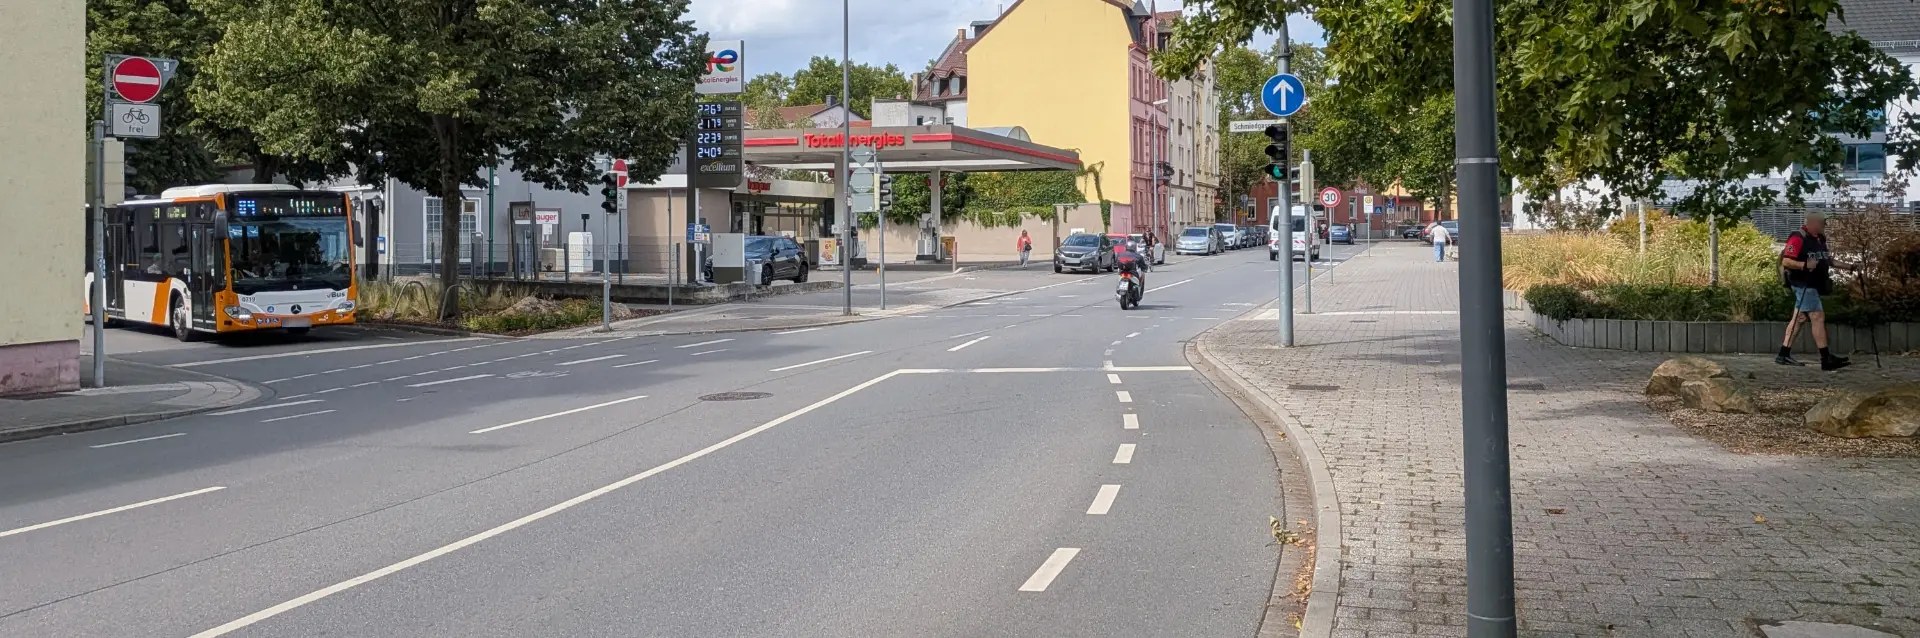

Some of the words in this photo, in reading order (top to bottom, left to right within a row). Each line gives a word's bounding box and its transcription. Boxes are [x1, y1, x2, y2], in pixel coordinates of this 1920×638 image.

[698, 118, 721, 129] 2179
[1233, 122, 1271, 131] Schmiedgass
[128, 125, 144, 134] frei
[698, 132, 721, 144] 2239
[698, 147, 721, 158] 2409
[700, 162, 736, 173] excellium
[1324, 193, 1336, 202] 30
